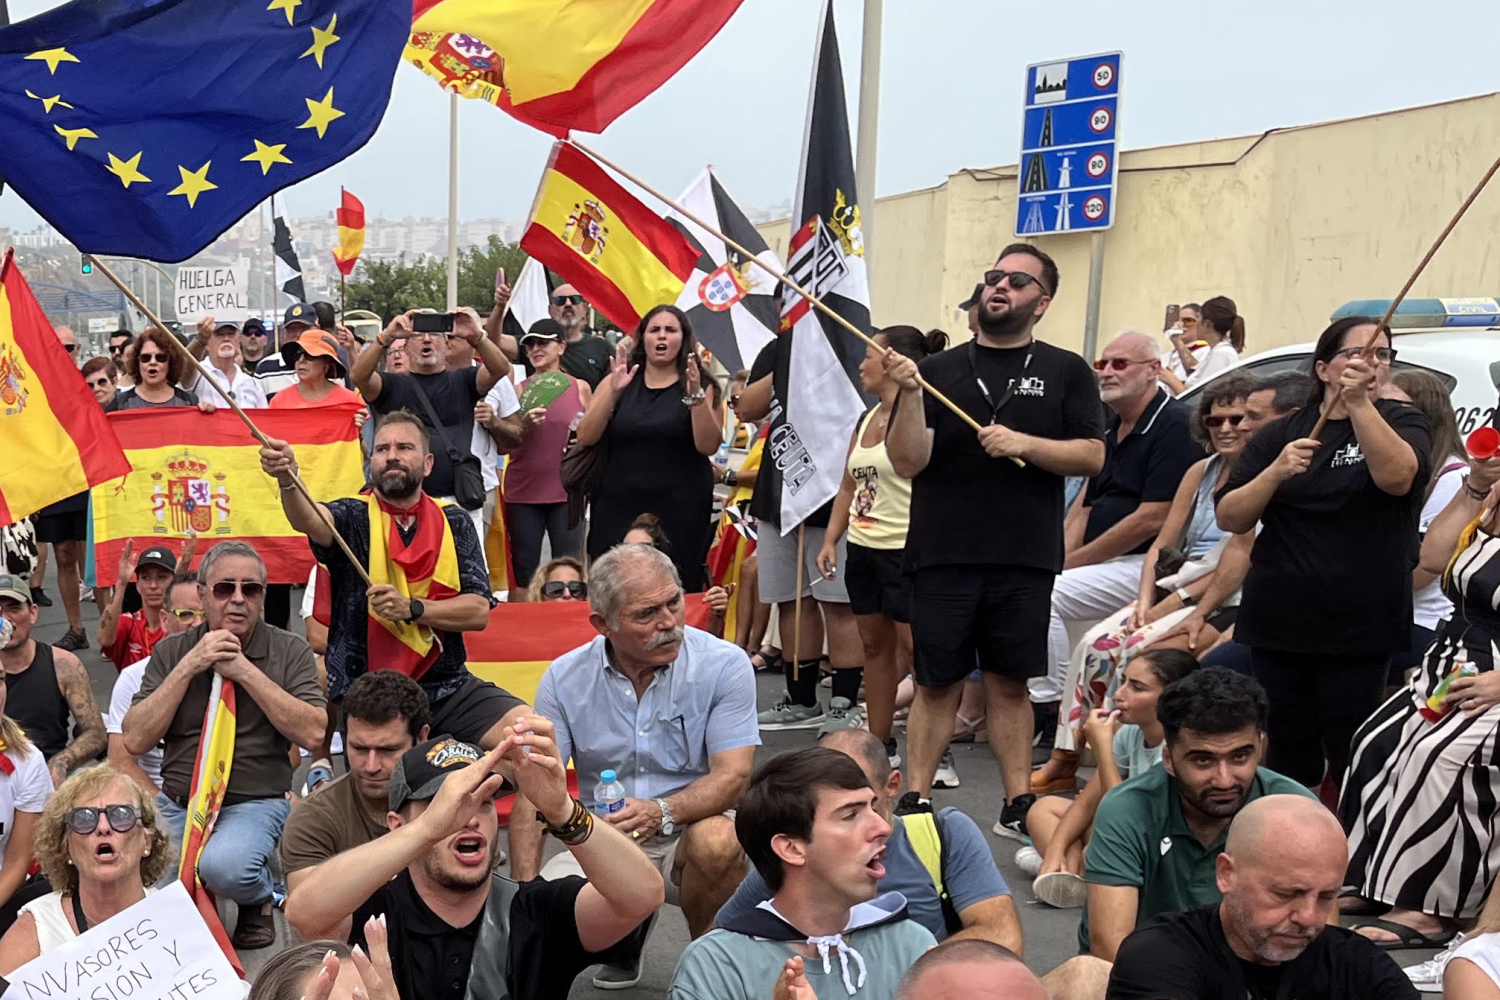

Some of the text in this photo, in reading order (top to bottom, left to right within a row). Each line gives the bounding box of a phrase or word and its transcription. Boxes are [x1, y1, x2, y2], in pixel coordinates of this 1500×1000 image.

[1096, 70, 1110, 81] 50
[1094, 115, 1107, 125] 90
[1091, 160, 1104, 169] 90
[1086, 203, 1103, 213] 120
[179, 269, 236, 290] HUELGA
[178, 293, 247, 315] GENERAL
[768, 422, 817, 497] CEUTA
[852, 465, 879, 480] CEUTA
[23, 918, 158, 1000] NVASORES
[162, 939, 181, 967] Y
